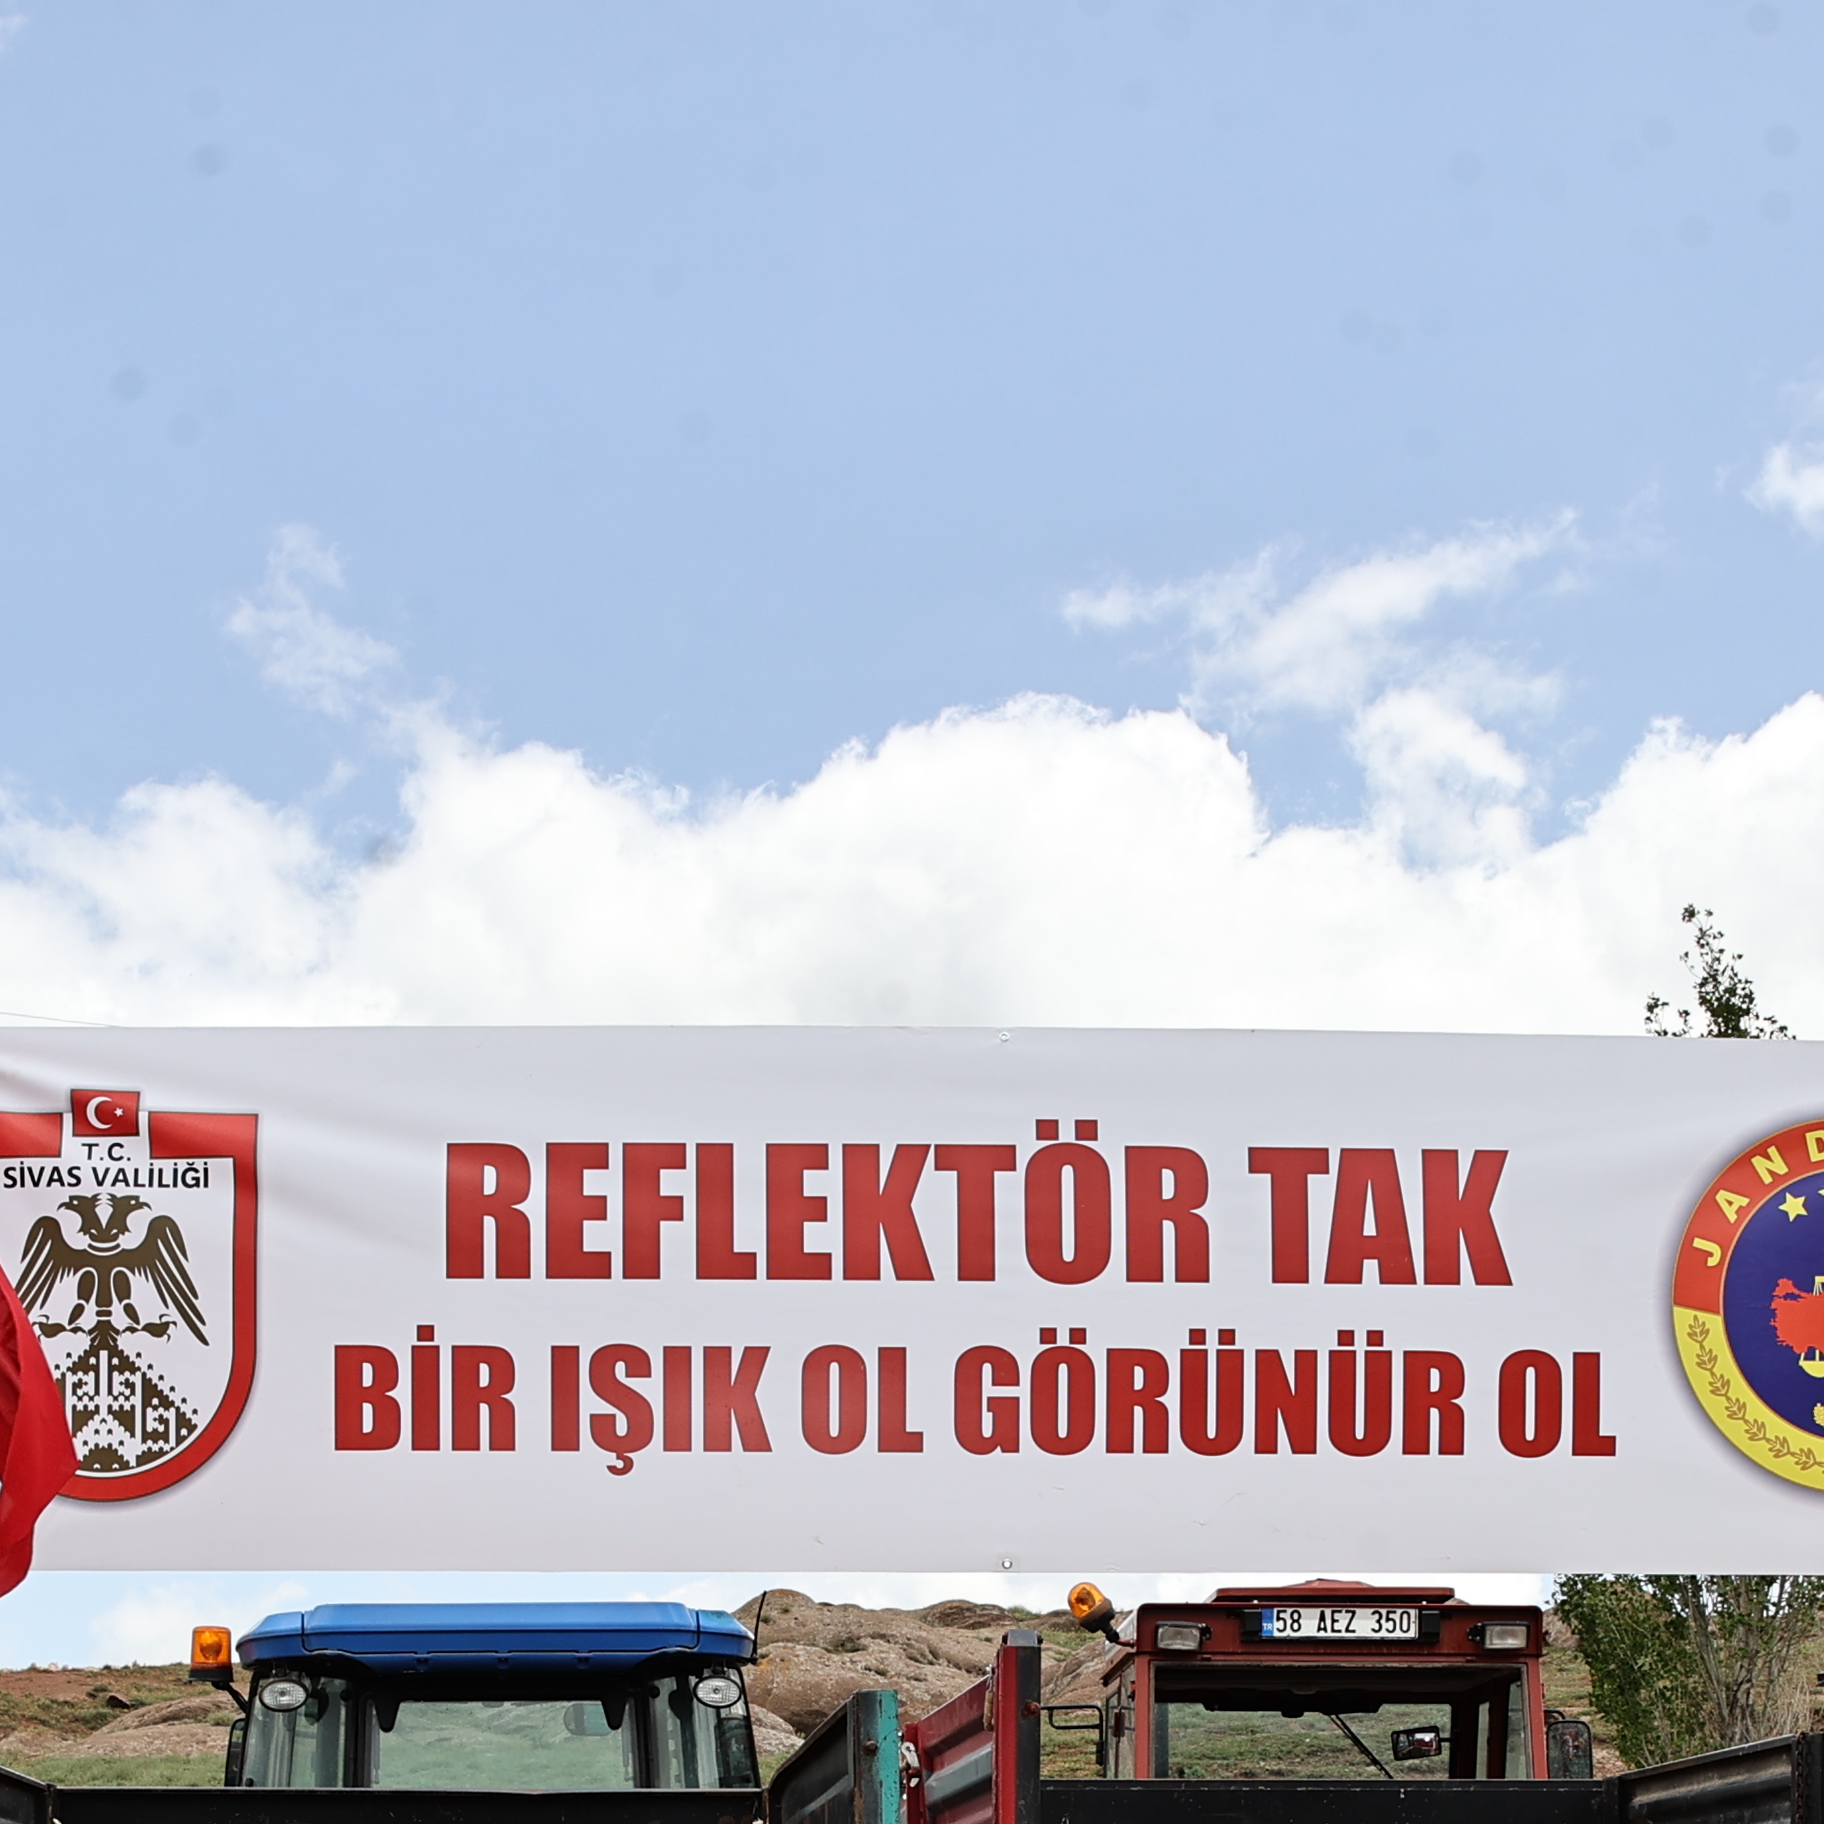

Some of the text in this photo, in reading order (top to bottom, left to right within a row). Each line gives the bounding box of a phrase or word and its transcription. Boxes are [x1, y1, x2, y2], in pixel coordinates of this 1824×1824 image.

[81, 1142, 131, 1161] T.C.
[3, 1161, 209, 1188] SİVAS VALİLİĞİ
[446, 1119, 1512, 1286] REFLEKTÖR TAK
[334, 1324, 1617, 1476] BİR IŞIK OL GÖRÜNÜR OL
[1276, 1609, 1302, 1633] 58
[1316, 1609, 1357, 1634] AEZ
[1370, 1610, 1411, 1634] 350
